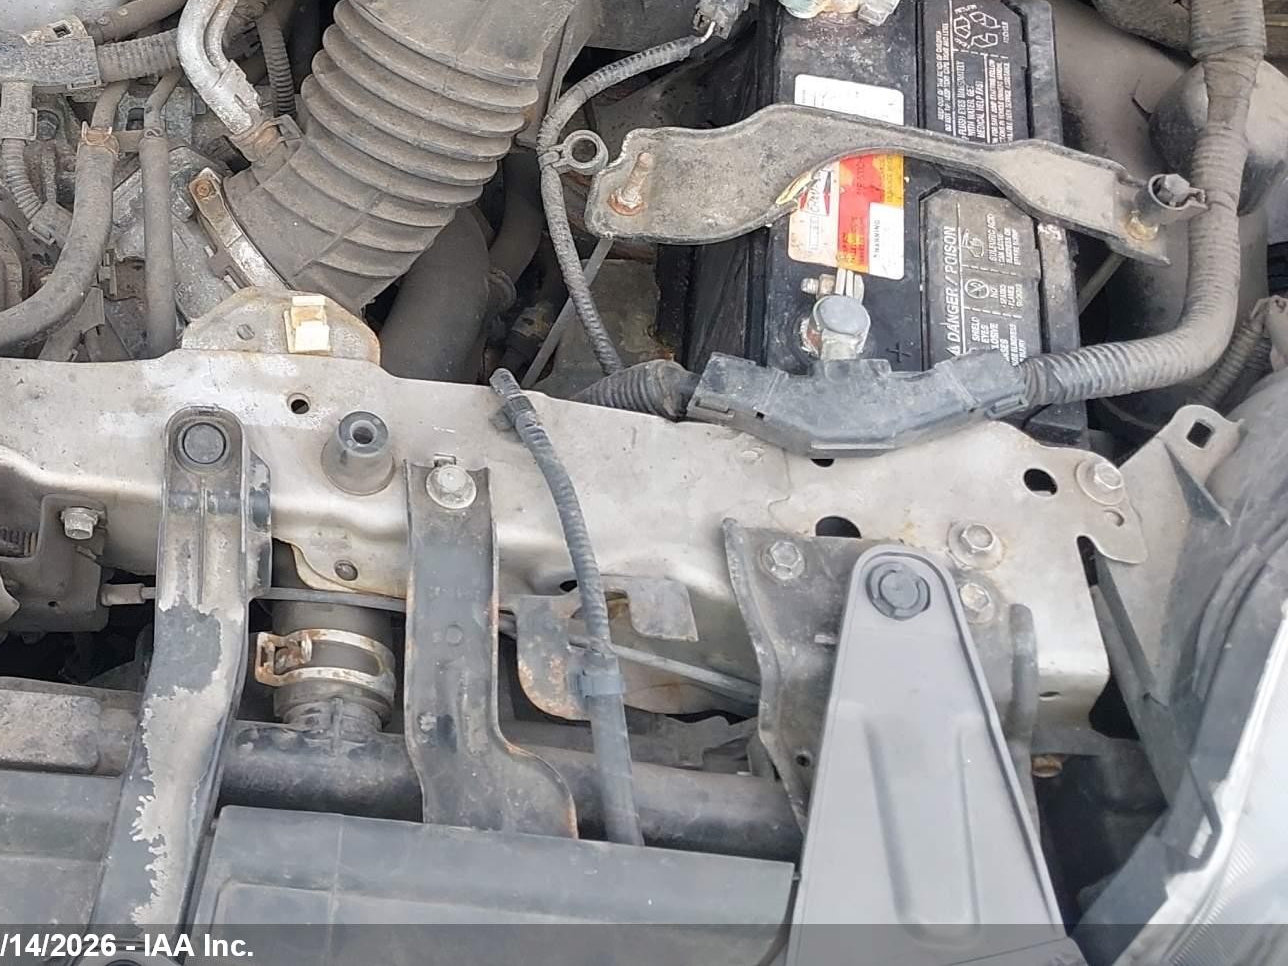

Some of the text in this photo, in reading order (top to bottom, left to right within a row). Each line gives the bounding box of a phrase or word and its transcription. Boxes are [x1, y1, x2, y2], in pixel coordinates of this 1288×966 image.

[957, 99, 966, 115] EYES
[976, 95, 984, 111] HELP
[977, 113, 985, 138] MEDICAL
[943, 226, 958, 274] POISON
[971, 316, 980, 341] SHIELD
[981, 324, 989, 343] EYES
